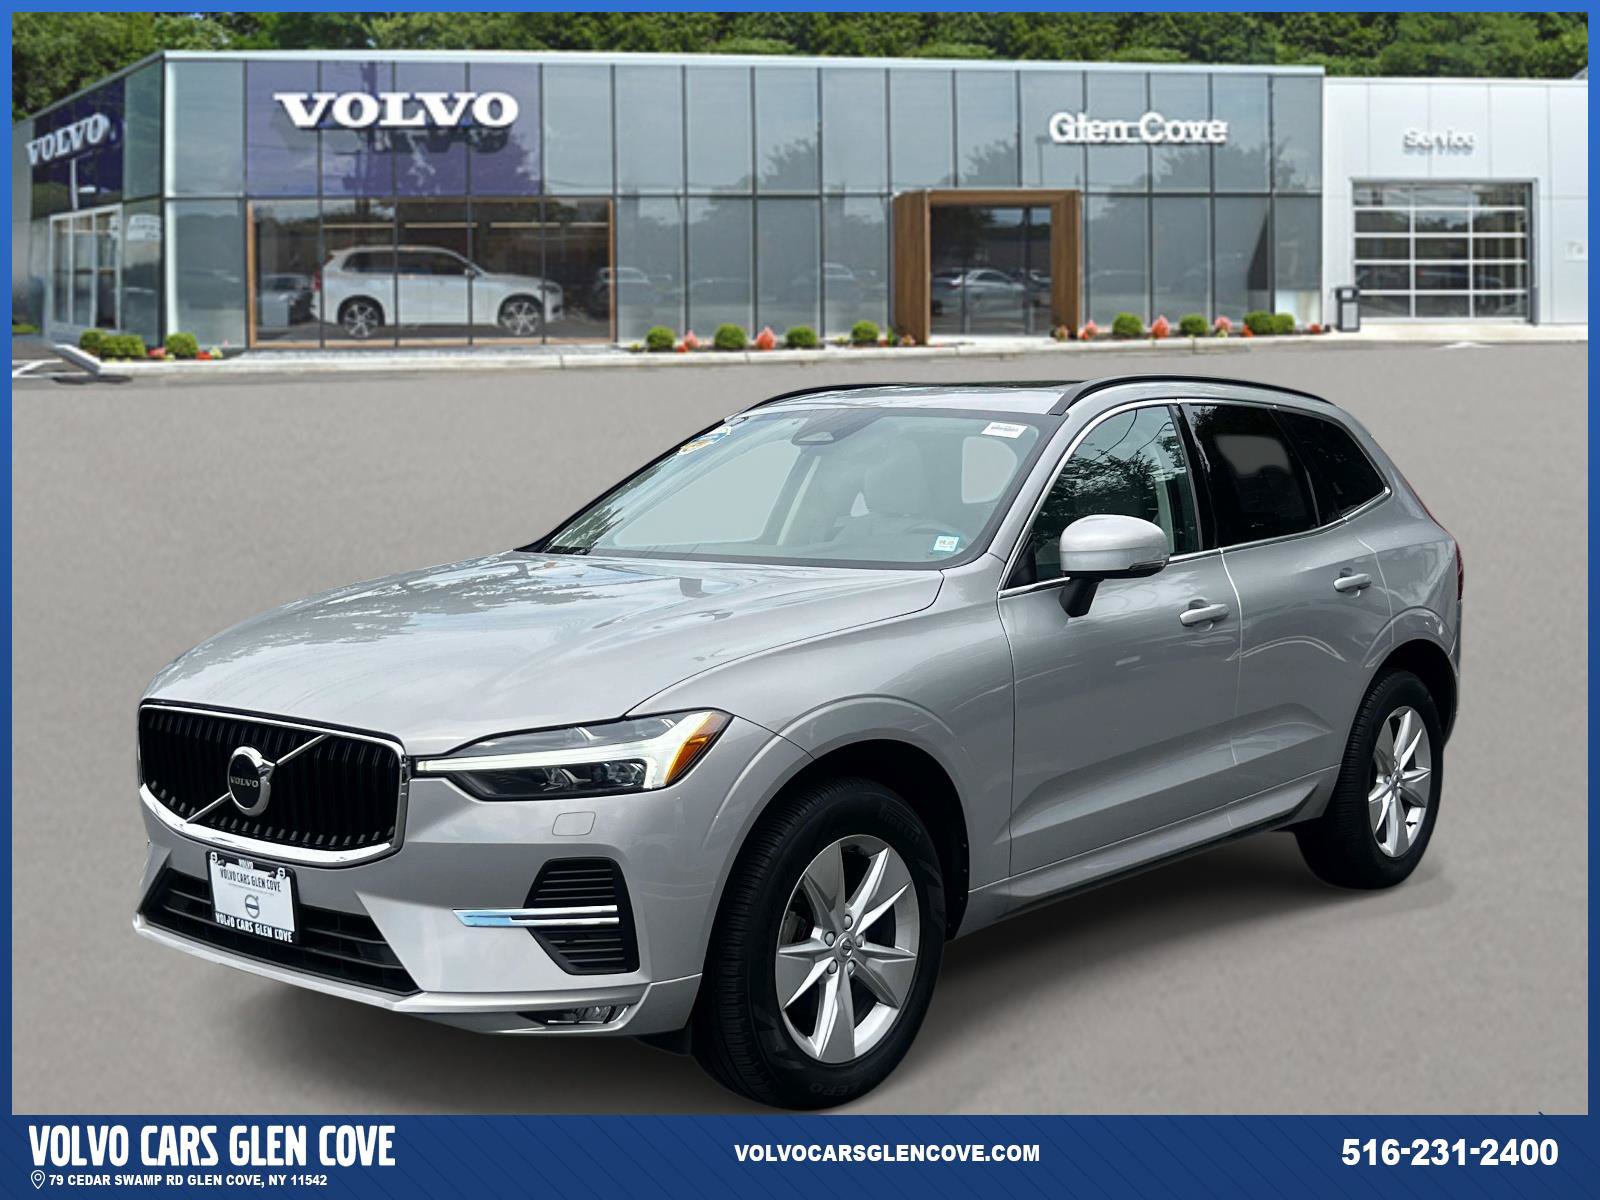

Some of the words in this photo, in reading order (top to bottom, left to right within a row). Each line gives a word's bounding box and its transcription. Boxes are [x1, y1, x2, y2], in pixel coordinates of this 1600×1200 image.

[274, 92, 519, 128] VOLVO
[25, 112, 110, 165] VOLVO
[1050, 111, 1130, 142] Glen
[1139, 111, 1228, 142] Cove
[1403, 127, 1474, 151] Service
[230, 776, 259, 788] VOLVO
[220, 867, 237, 882] VOLVO
[237, 872, 251, 886] CARS
[251, 876, 266, 889] GLEN
[266, 880, 281, 892] COVE
[215, 912, 236, 928] VOLVO
[237, 918, 254, 933] CARS
[255, 924, 273, 938] GLEN
[274, 928, 293, 943] COVE
